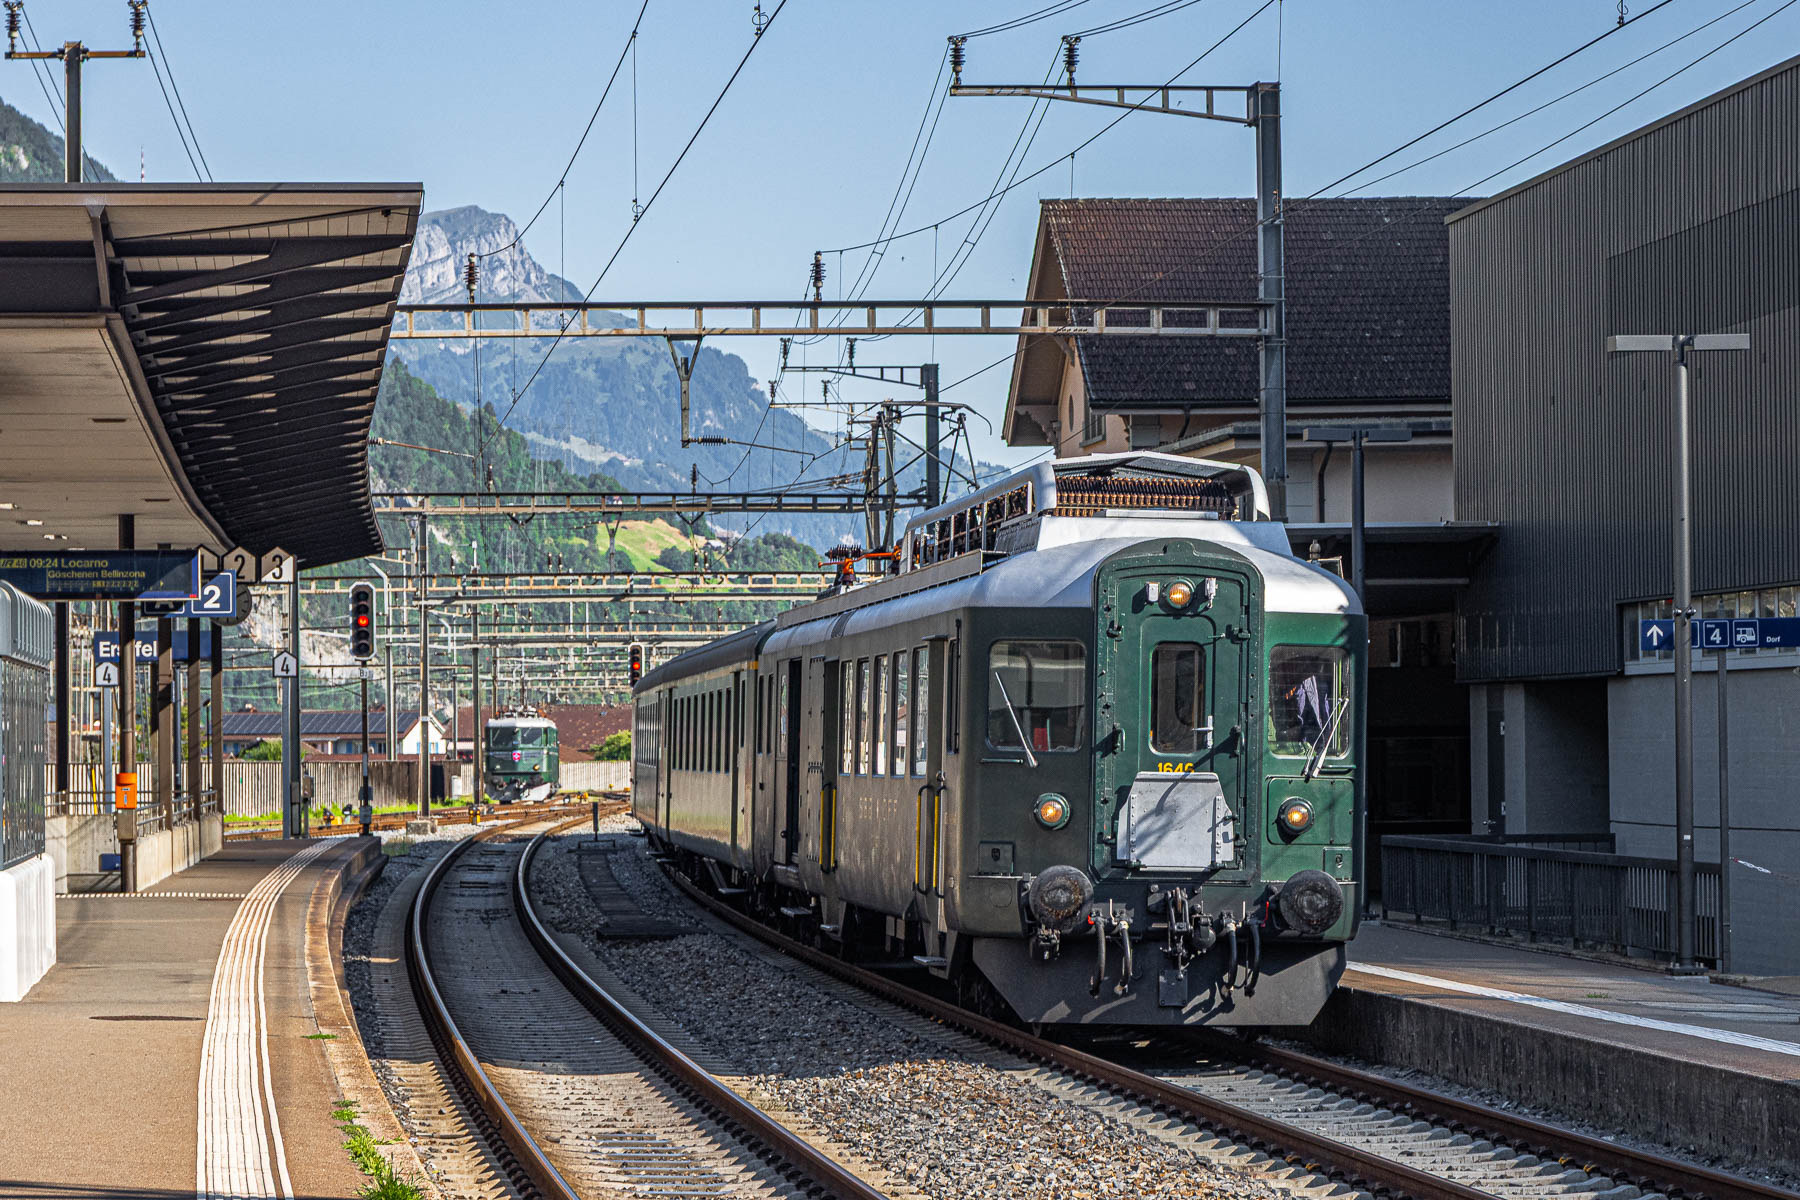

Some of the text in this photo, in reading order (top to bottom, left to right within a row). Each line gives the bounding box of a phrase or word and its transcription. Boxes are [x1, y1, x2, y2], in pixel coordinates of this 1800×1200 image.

[29, 558, 58, 568] 09:24
[61, 558, 108, 568] Locarno
[234, 554, 245, 579] 2
[271, 554, 283, 579] 3
[48, 569, 146, 578] Göschenen Bellinzona
[203, 585, 221, 608] 2
[1710, 628, 1722, 644] 4
[103, 665, 111, 683] 4
[280, 657, 290, 675] 4
